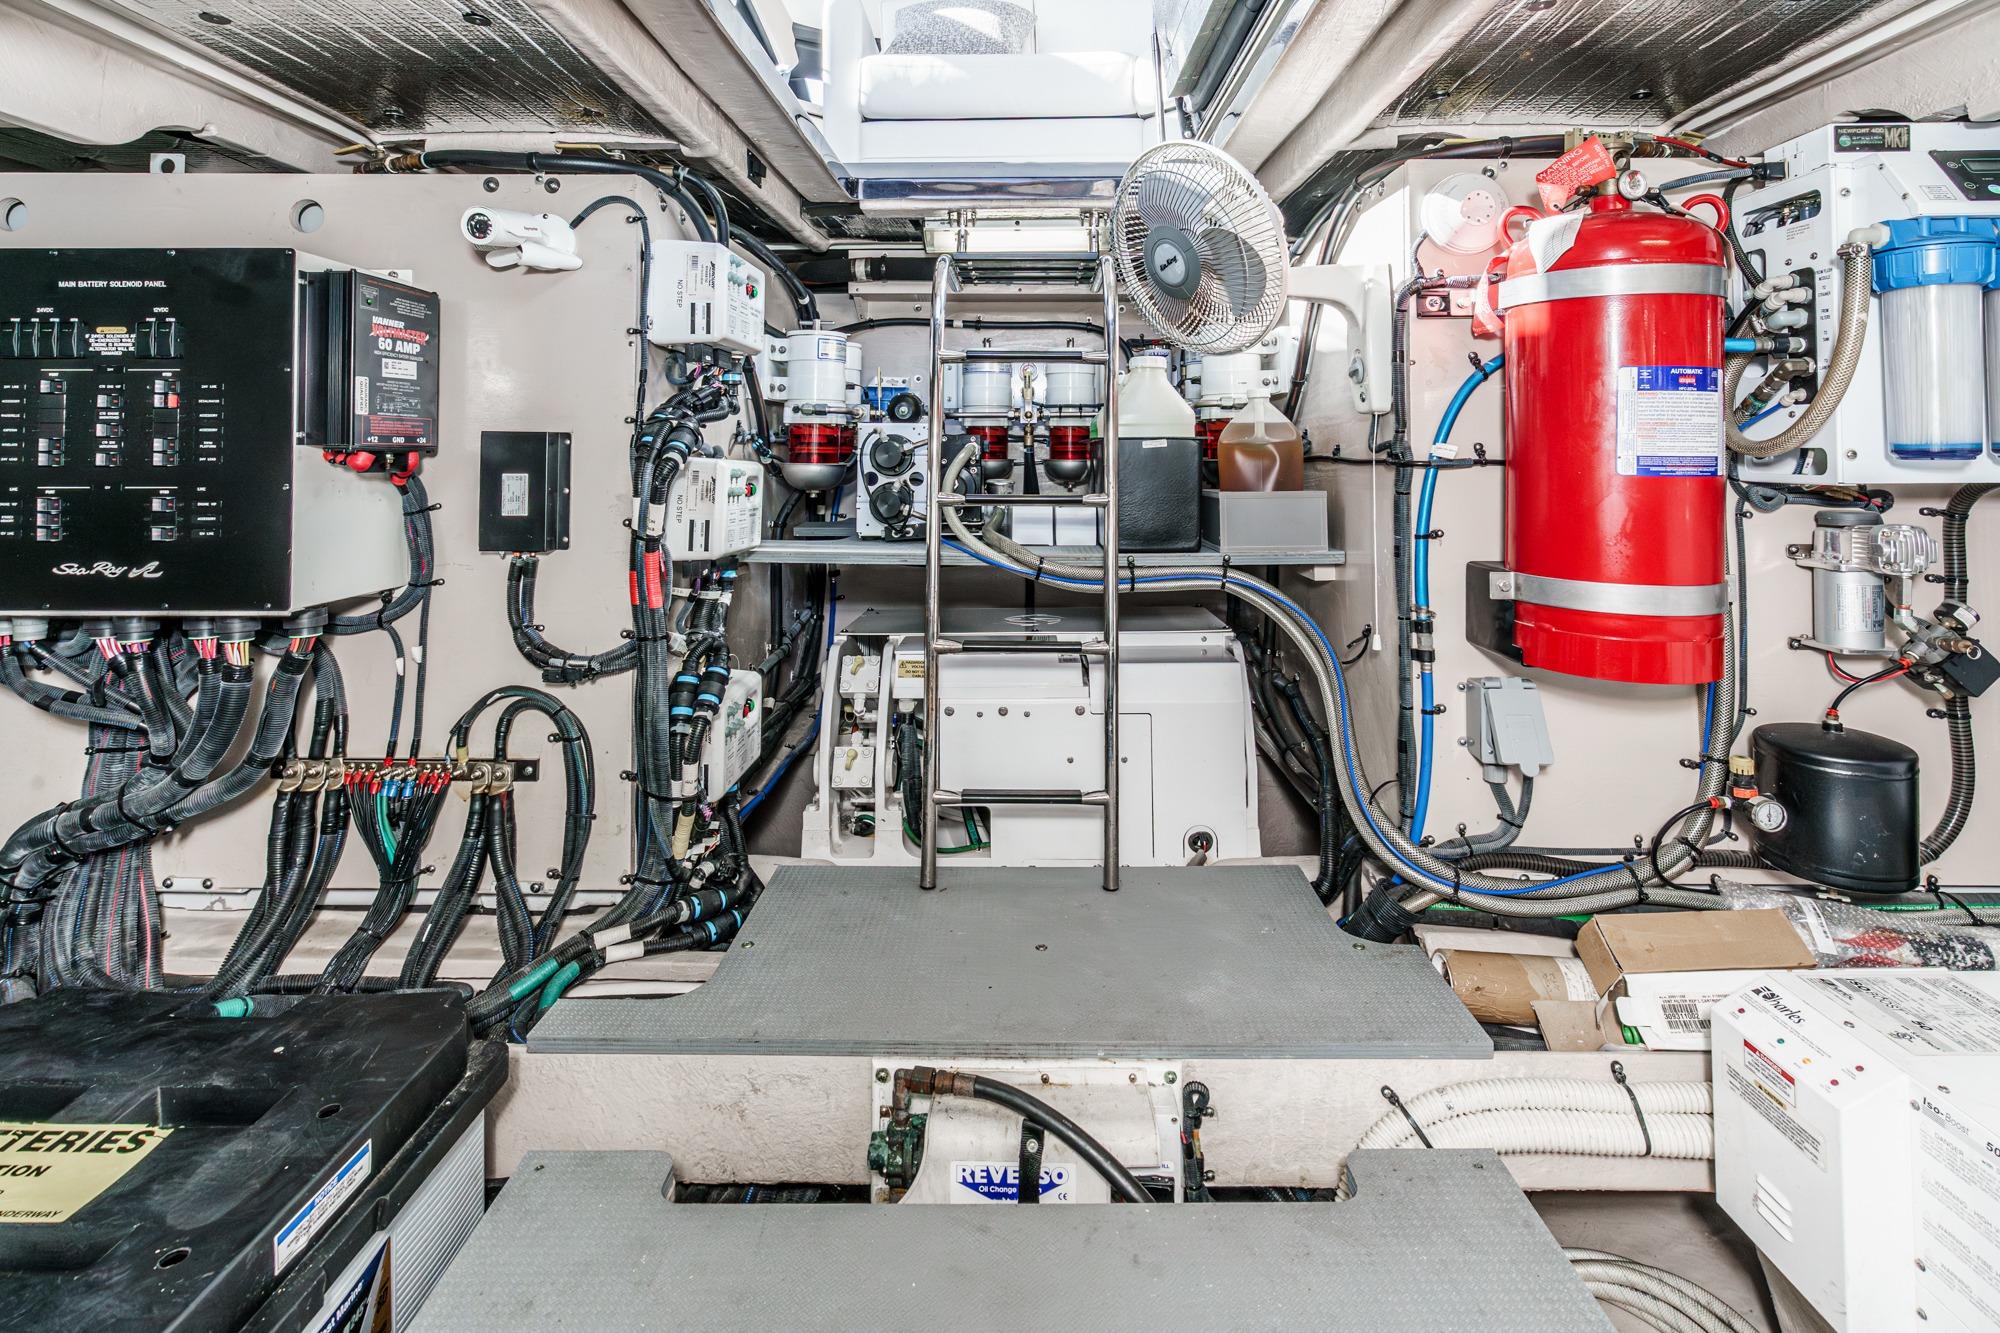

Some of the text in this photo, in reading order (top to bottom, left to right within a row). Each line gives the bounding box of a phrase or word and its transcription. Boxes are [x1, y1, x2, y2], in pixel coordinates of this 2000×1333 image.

[1537, 147, 1583, 180] WARNING
[678, 280, 683, 289] NO
[373, 316, 405, 329] VANNER
[378, 337, 420, 355] 60 AMP
[678, 495, 683, 505] NO
[52, 561, 128, 577] Sea Ray
[1761, 986, 1806, 1024] Charles
[1923, 1097, 1969, 1136] Iso-Boost
[956, 1165, 1069, 1184] REVESO
[314, 1176, 340, 1206] NOTICE
[336, 1279, 365, 1321] Marine
